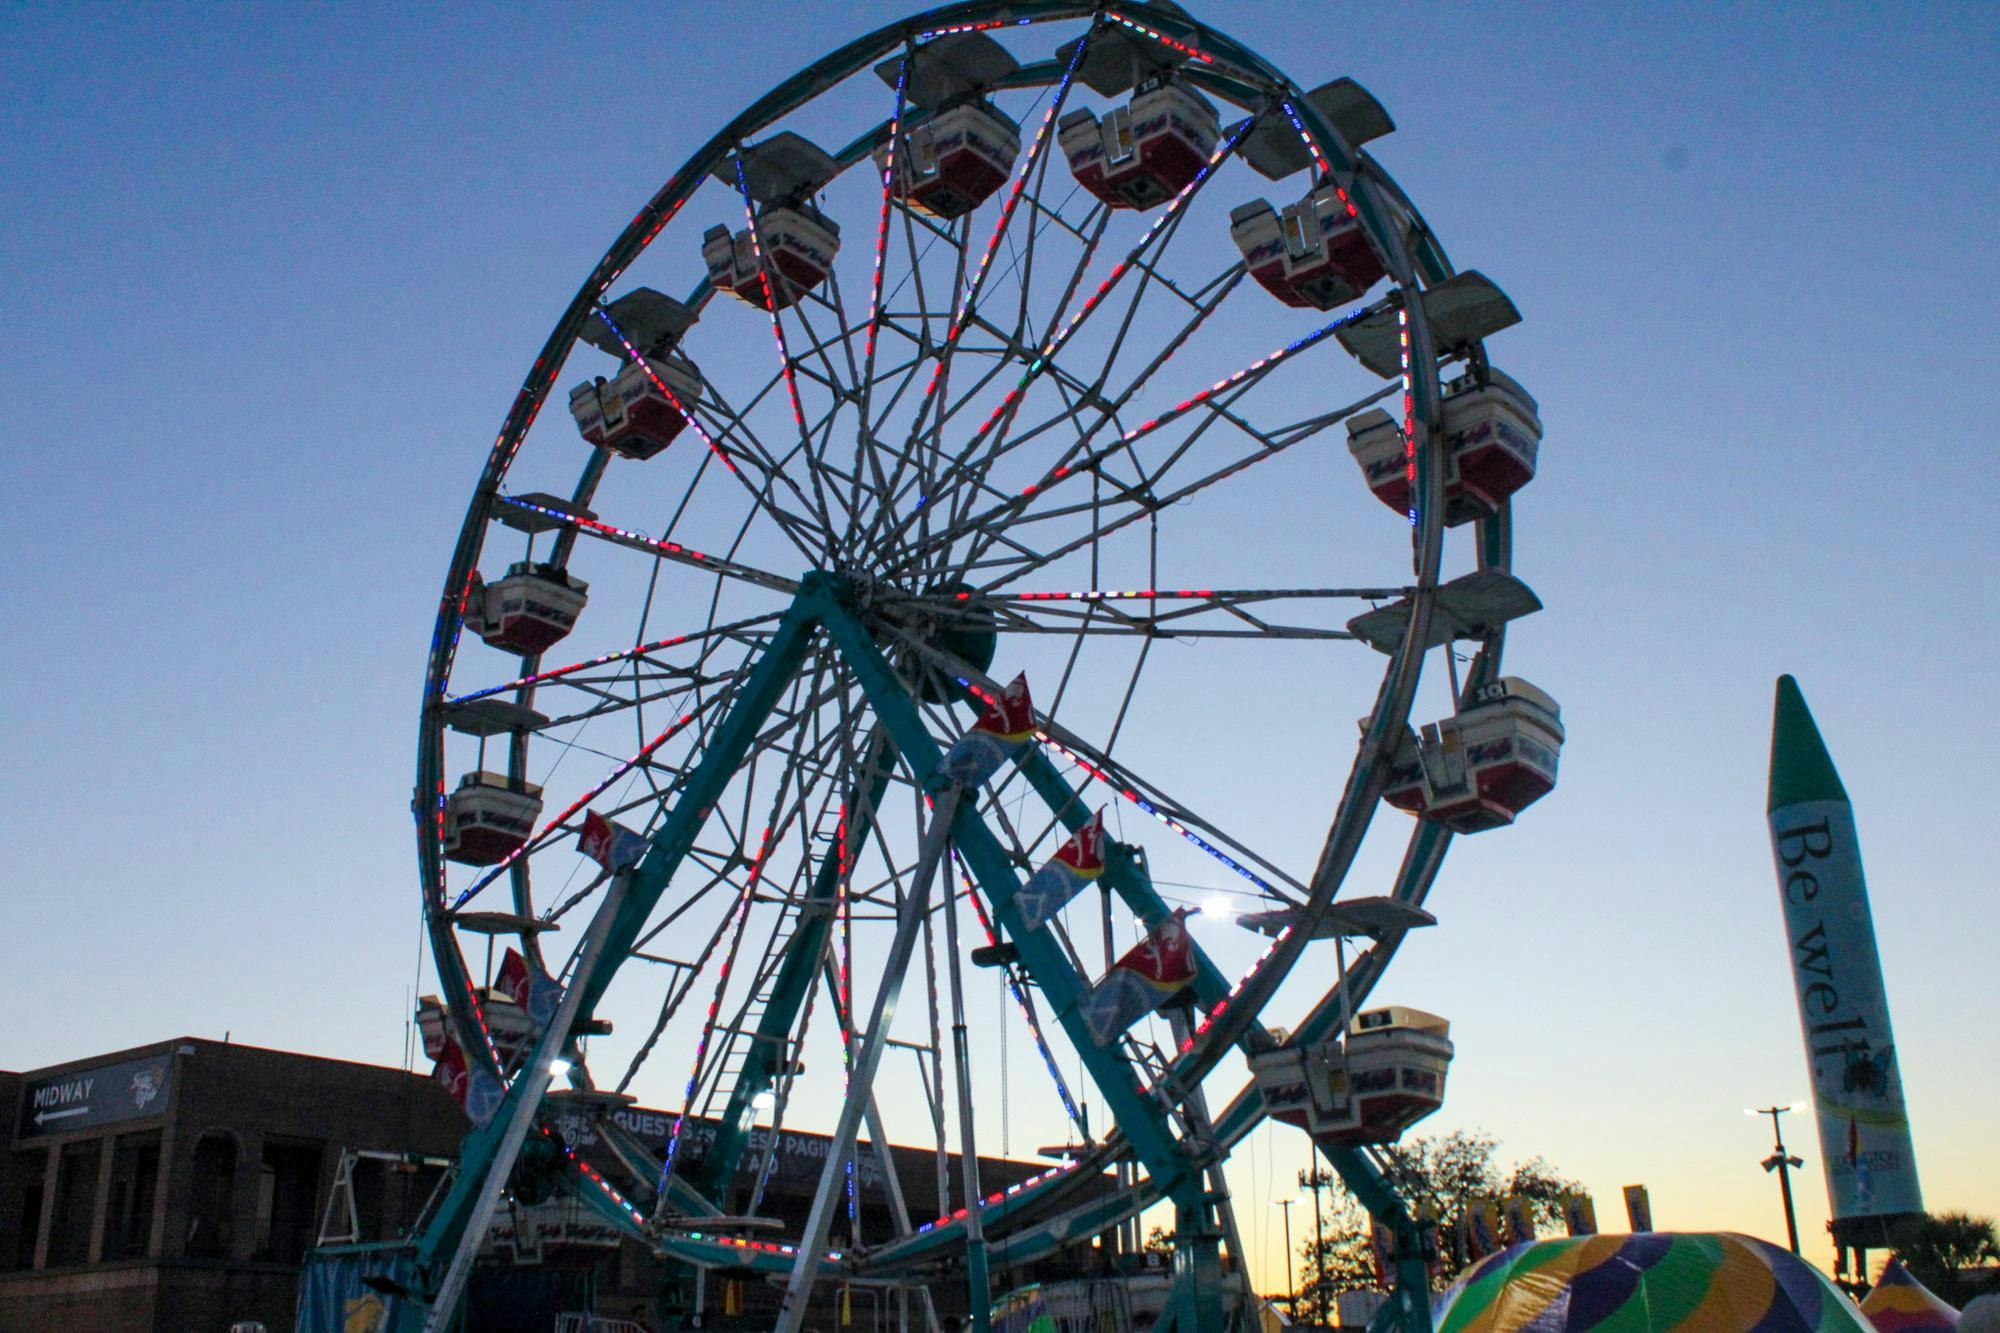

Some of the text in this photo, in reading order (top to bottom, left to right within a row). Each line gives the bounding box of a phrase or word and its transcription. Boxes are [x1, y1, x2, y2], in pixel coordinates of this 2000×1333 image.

[1475, 681, 1501, 702] 10
[1777, 816, 1833, 905] Be
[33, 1077, 95, 1109] MIDWAY
